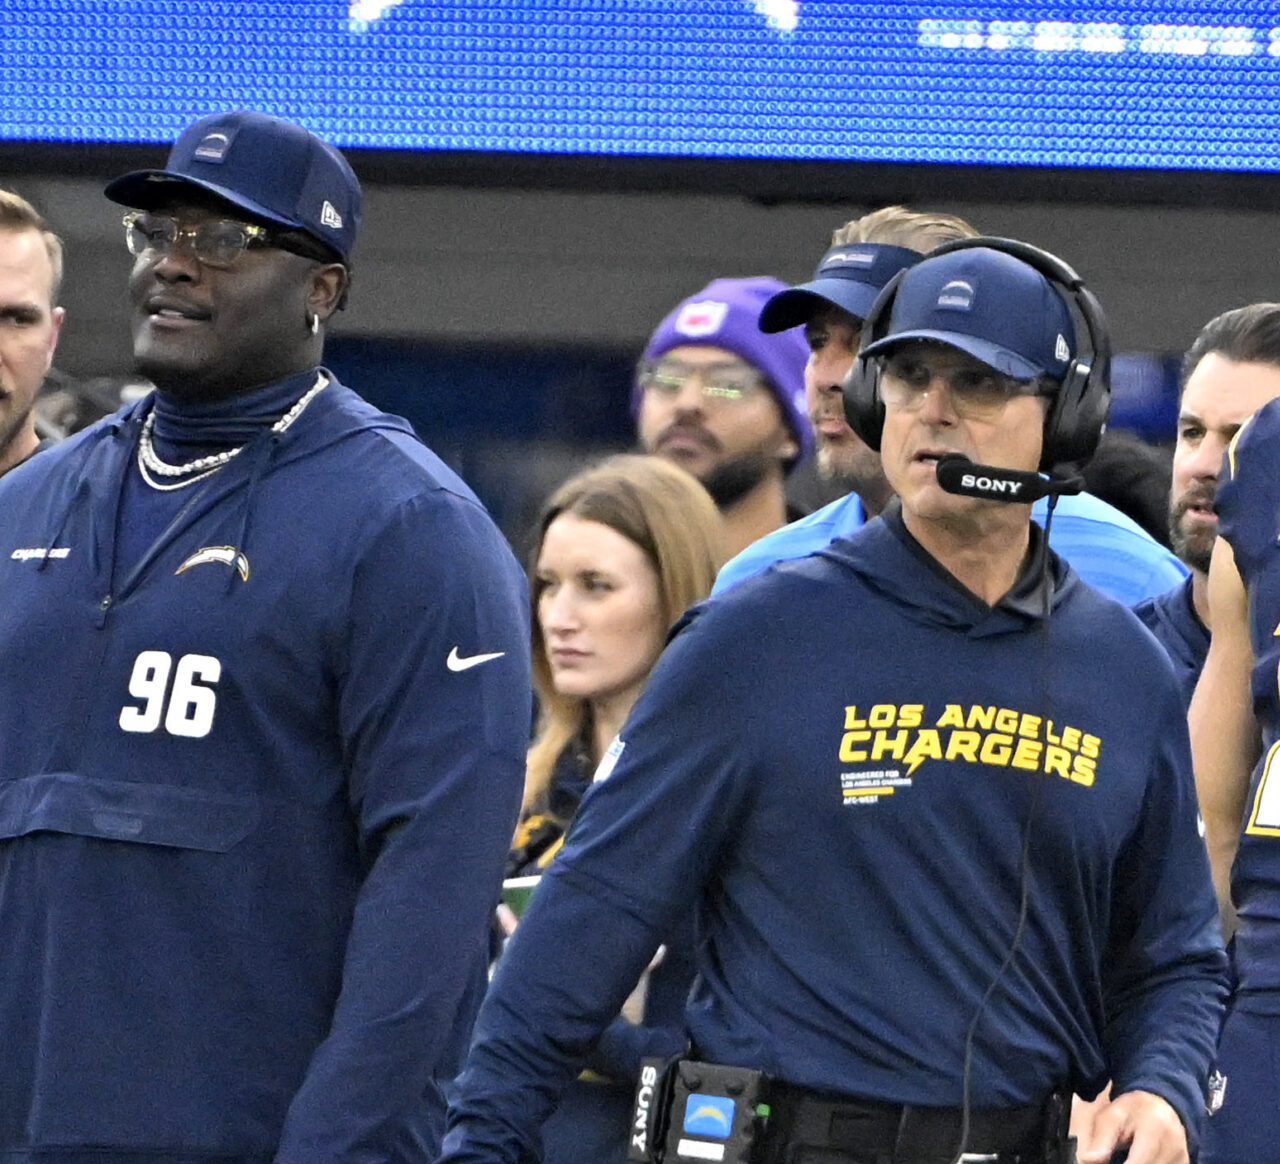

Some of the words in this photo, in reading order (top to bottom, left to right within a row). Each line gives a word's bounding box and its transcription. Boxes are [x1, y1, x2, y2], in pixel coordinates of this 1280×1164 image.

[961, 474, 1022, 494] SONY
[119, 650, 221, 738] 96
[839, 729, 1097, 787] CHARGERS
[844, 704, 924, 730] LOS
[936, 704, 1101, 758] ANGELES
[632, 1066, 657, 1153] SONY
